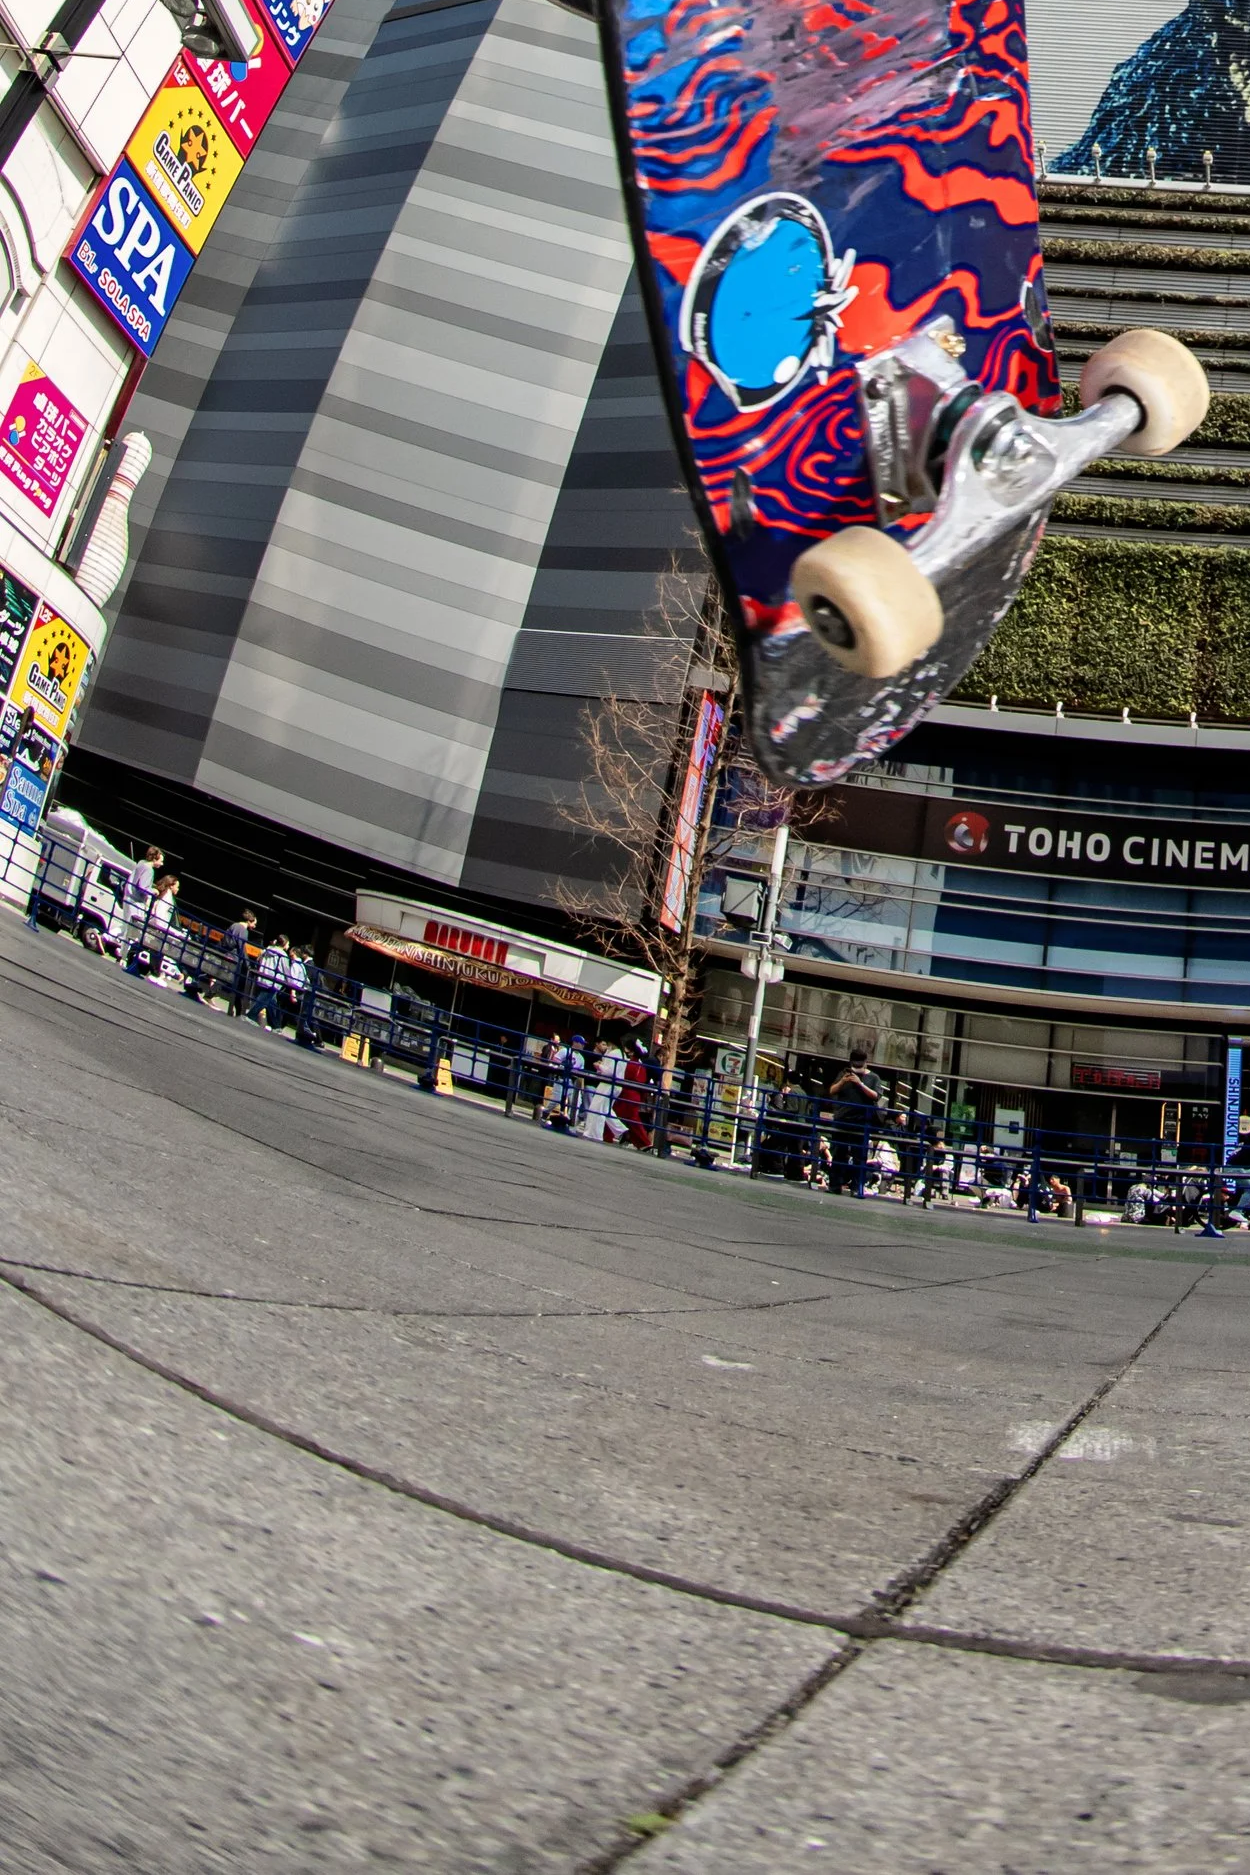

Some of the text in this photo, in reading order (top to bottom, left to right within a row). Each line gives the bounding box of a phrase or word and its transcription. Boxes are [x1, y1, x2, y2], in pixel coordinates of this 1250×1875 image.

[156, 133, 202, 212] GAME PANIC
[91, 176, 176, 318] SPA
[33, 392, 78, 443] 卓球バー
[36, 417, 73, 459] カラオケ
[28, 663, 50, 697] GAME
[4, 788, 27, 822] Spa
[9, 765, 45, 807] Sauna
[1003, 824, 1111, 863] TOHO
[412, 950, 499, 986] SHINJUKU
[1226, 1077, 1240, 1138] SHINJUKU
